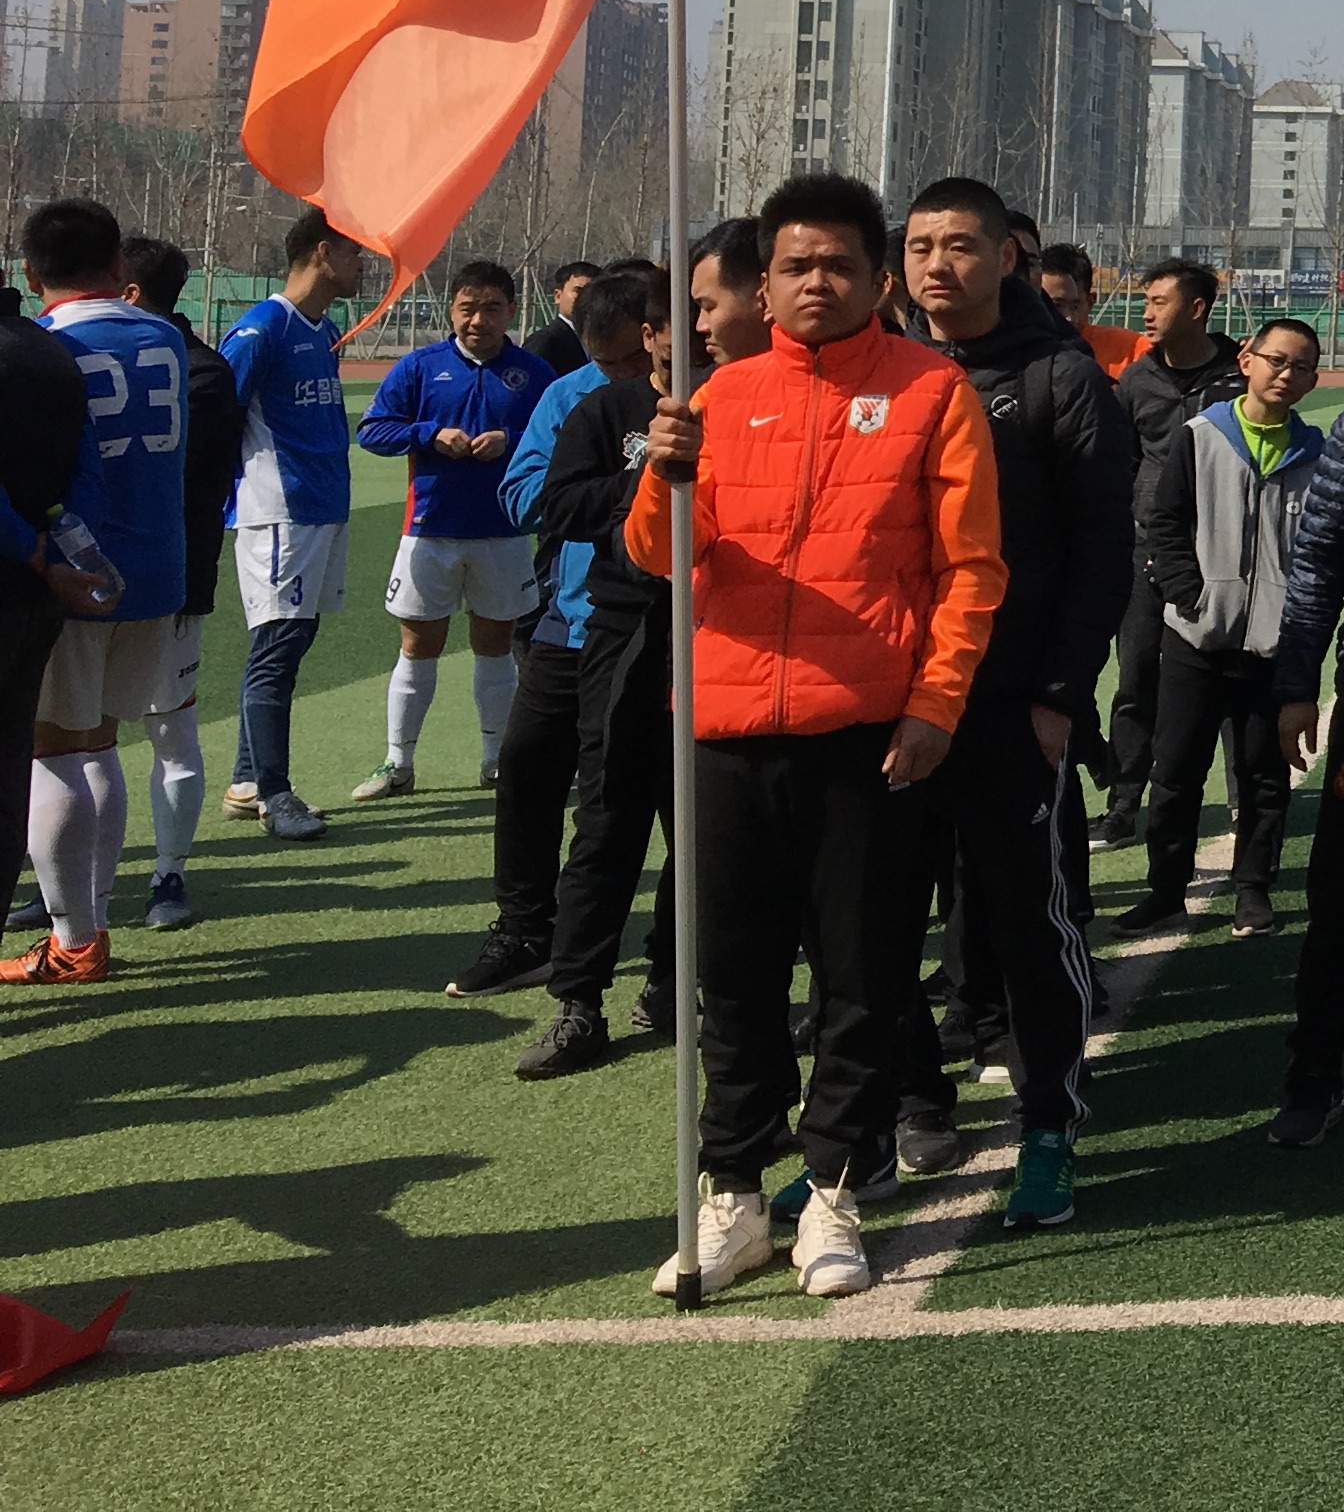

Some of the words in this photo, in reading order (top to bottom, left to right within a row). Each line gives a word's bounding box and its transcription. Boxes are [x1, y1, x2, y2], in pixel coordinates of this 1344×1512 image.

[76, 347, 181, 459] 23
[290, 575, 304, 607] 3
[384, 577, 402, 604] 9
